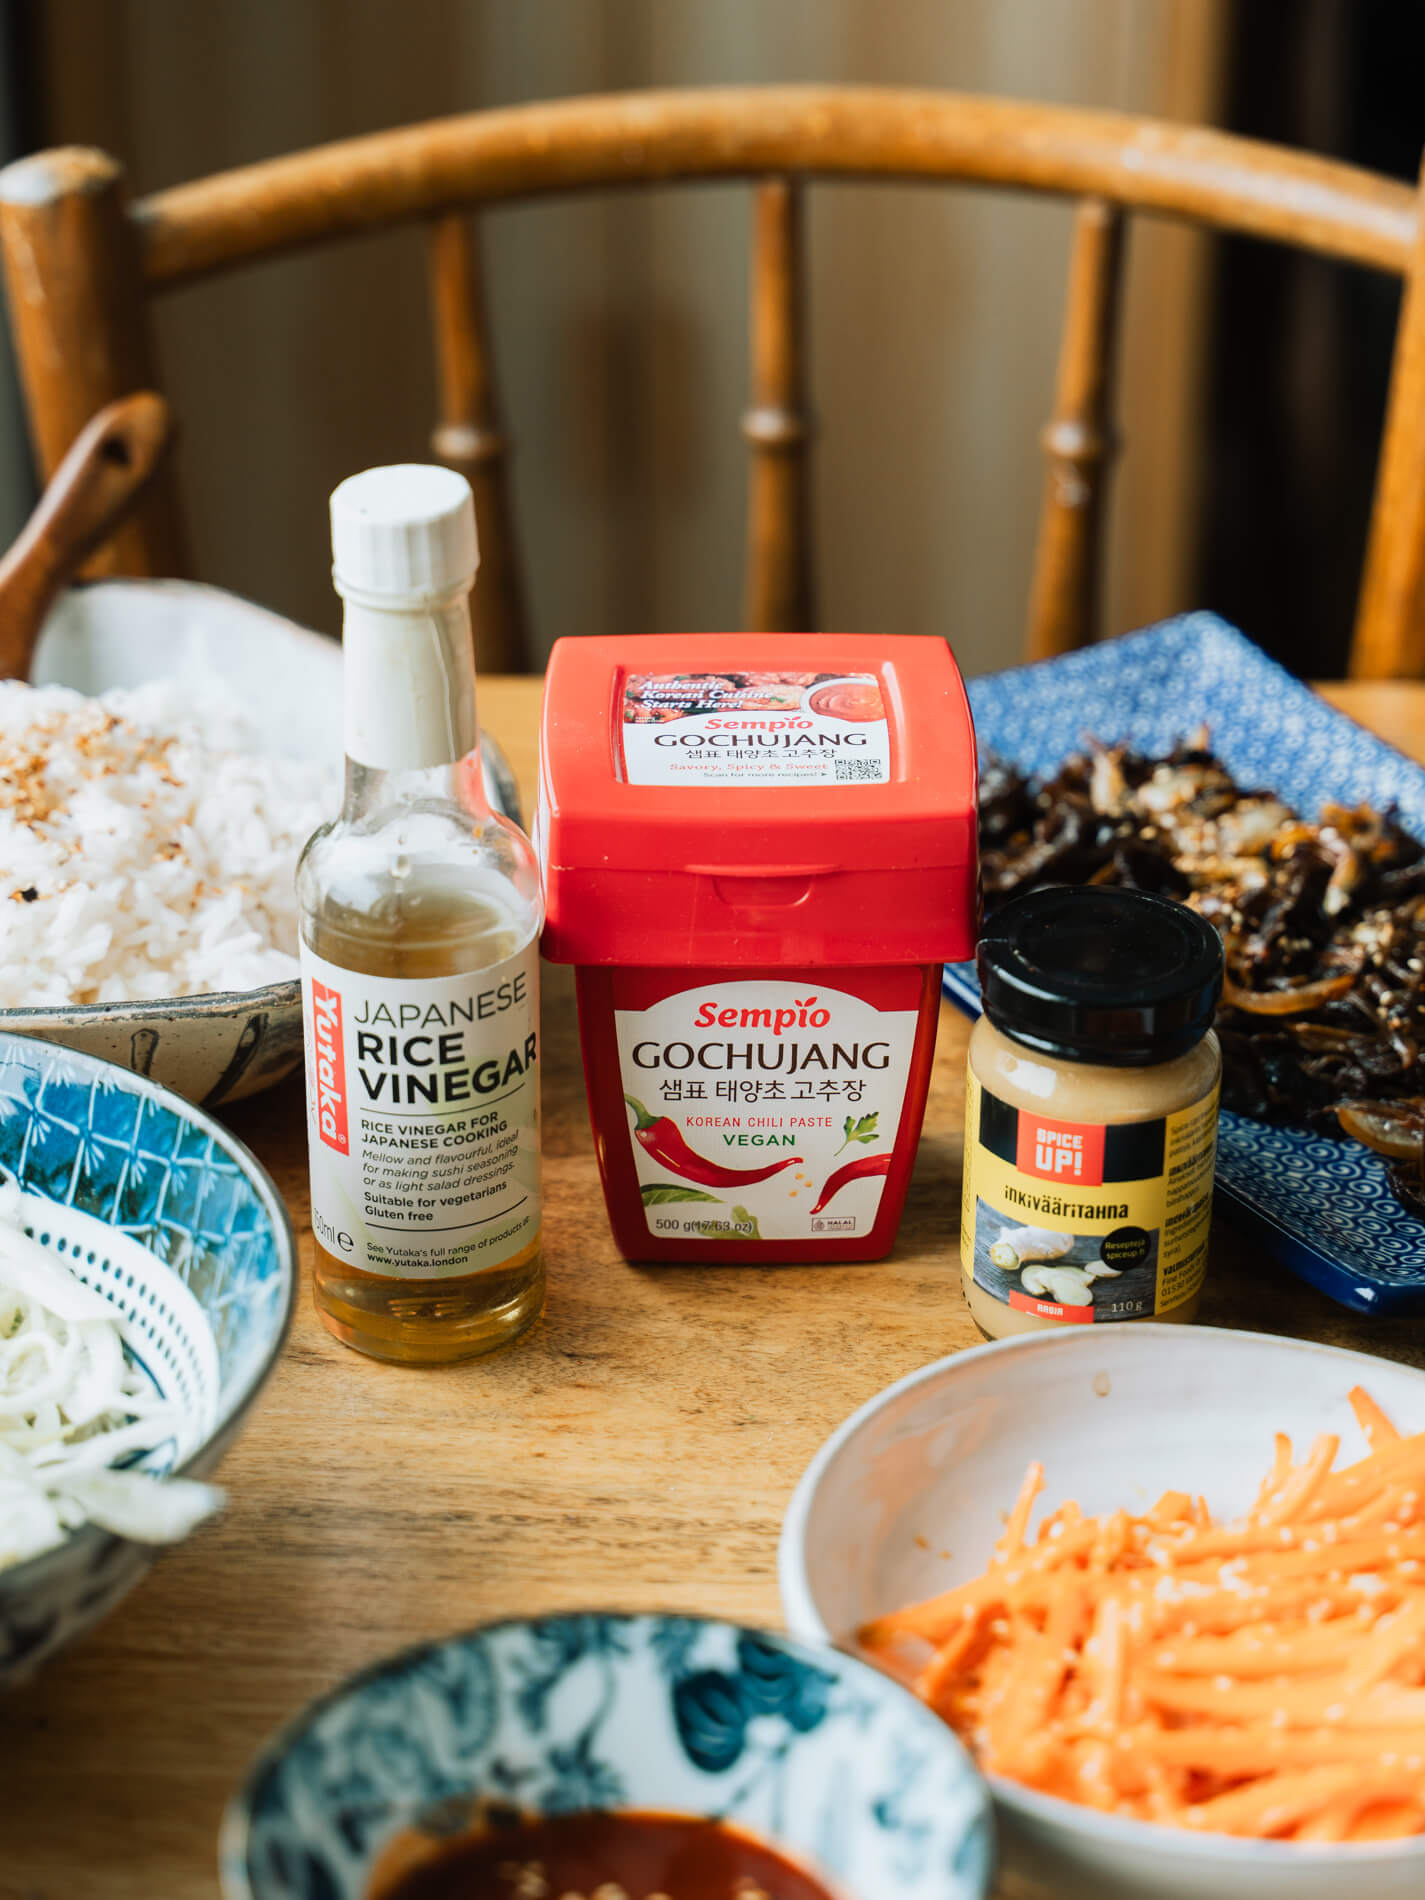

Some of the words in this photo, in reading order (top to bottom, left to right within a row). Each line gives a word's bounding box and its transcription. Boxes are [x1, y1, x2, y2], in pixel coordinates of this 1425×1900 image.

[640, 680, 724, 690] Authentic
[640, 690, 704, 699] Korean
[709, 690, 773, 699] Cuisine
[641, 700, 694, 709] Starts
[696, 700, 743, 709] Here!
[704, 716, 814, 732] Sempio
[653, 734, 867, 748] GOCHUJANG
[685, 749, 721, 760] 샘표
[726, 749, 779, 760] 태양초
[782, 748, 838, 759] 고추장
[669, 763, 722, 771] Savory,
[727, 763, 765, 771] Spicy
[354, 972, 527, 1029] JAPANESE
[694, 996, 831, 1036] Sempio
[357, 1030, 466, 1067] RICE
[632, 1041, 890, 1074] GOCHUJANG
[358, 1031, 537, 1104] VINEGAR
[659, 1079, 709, 1101] 샘표
[716, 1079, 786, 1103] 태양초
[791, 1079, 867, 1103] 고추장
[361, 1119, 393, 1134] RICE
[398, 1121, 466, 1136] VINEGAR
[470, 1111, 499, 1128] FOR
[686, 1116, 740, 1128] KOREAN
[747, 1116, 784, 1128] CHILI
[790, 1116, 833, 1127] PASTE
[361, 1134, 439, 1149] JAPANESE
[443, 1120, 508, 1147] COOKING
[722, 1134, 796, 1146] VEGAN
[1037, 1128, 1083, 1150] SPICE
[362, 1150, 403, 1164] Mellow
[407, 1154, 432, 1165] and
[495, 1129, 519, 1149] ideal
[363, 1163, 379, 1173] for
[383, 1168, 429, 1180] making
[432, 1165, 464, 1177] sushi
[467, 1145, 519, 1173] seasoning
[1036, 1144, 1083, 1176] UP!
[363, 1177, 376, 1185] or
[378, 1180, 392, 1189] as
[395, 1180, 423, 1193] light
[427, 1177, 460, 1191] salad
[364, 1191, 414, 1208] Suitable
[417, 1195, 436, 1207] for
[440, 1182, 507, 1207] vegetarians
[364, 1206, 404, 1220] Gluten
[408, 1211, 434, 1221] free
[656, 1219, 679, 1230] 500
[734, 1220, 753, 1233] oz)
[367, 1242, 384, 1253] See
[386, 1247, 428, 1257] Yutaka's
[430, 1248, 446, 1257] full
[448, 1243, 476, 1256] range
[477, 1239, 488, 1249] of
[489, 1223, 523, 1245] products
[367, 1253, 468, 1268] www.yutaka.london
[1112, 1301, 1134, 1313] 110
[1136, 1301, 1143, 1311] g
